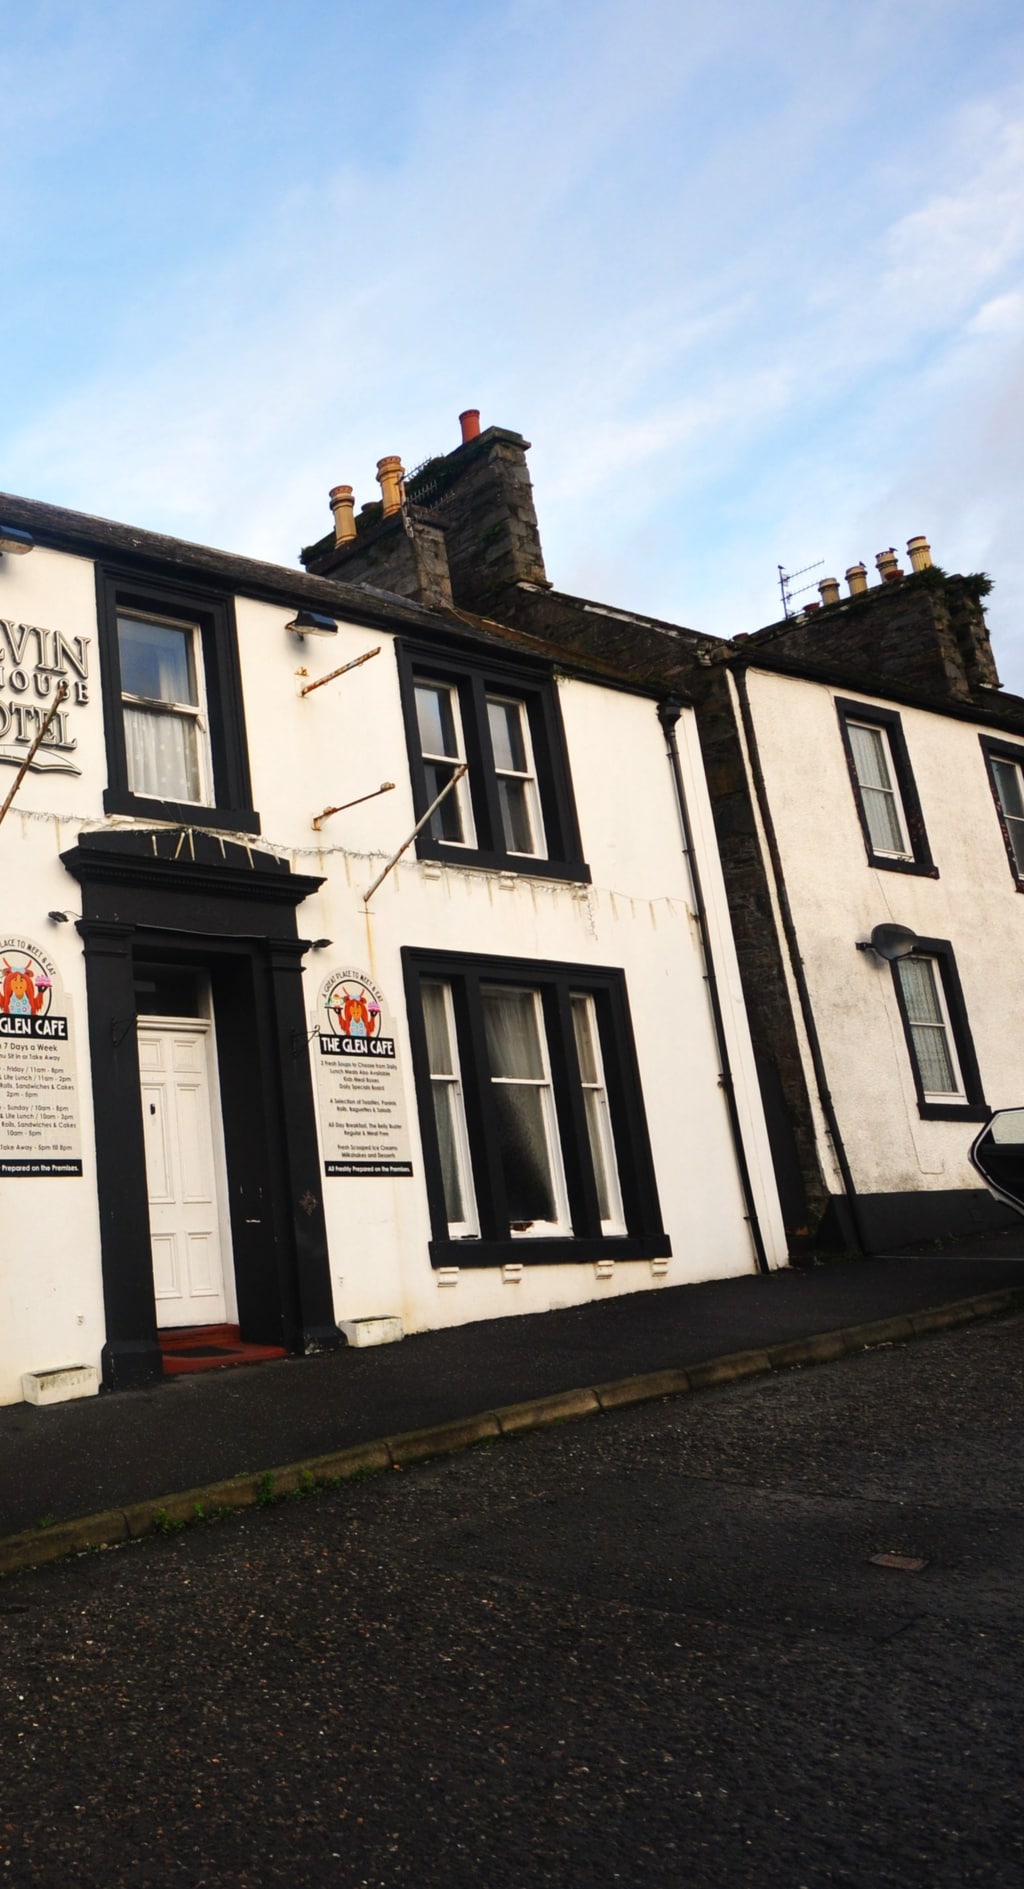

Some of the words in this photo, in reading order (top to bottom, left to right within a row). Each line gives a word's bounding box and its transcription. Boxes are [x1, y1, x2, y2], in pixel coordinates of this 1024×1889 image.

[17, 939, 26, 949] TO
[27, 944, 43, 959] MEET
[45, 961, 56, 976] EAT
[325, 975, 336, 993] GREAT
[336, 971, 351, 980] PLACE
[352, 971, 359, 979] TO
[360, 975, 373, 988] MEET
[374, 990, 384, 1003] EAT
[35, 1020, 66, 1036] CAFE
[10, 1043, 29, 1051] Days
[37, 1044, 57, 1052] Week
[321, 1038, 340, 1052] THE
[342, 1038, 368, 1054] GLEN
[370, 1041, 394, 1055] CAFE
[7, 1066, 24, 1074] Friday
[2, 1165, 30, 1173] Prepared
